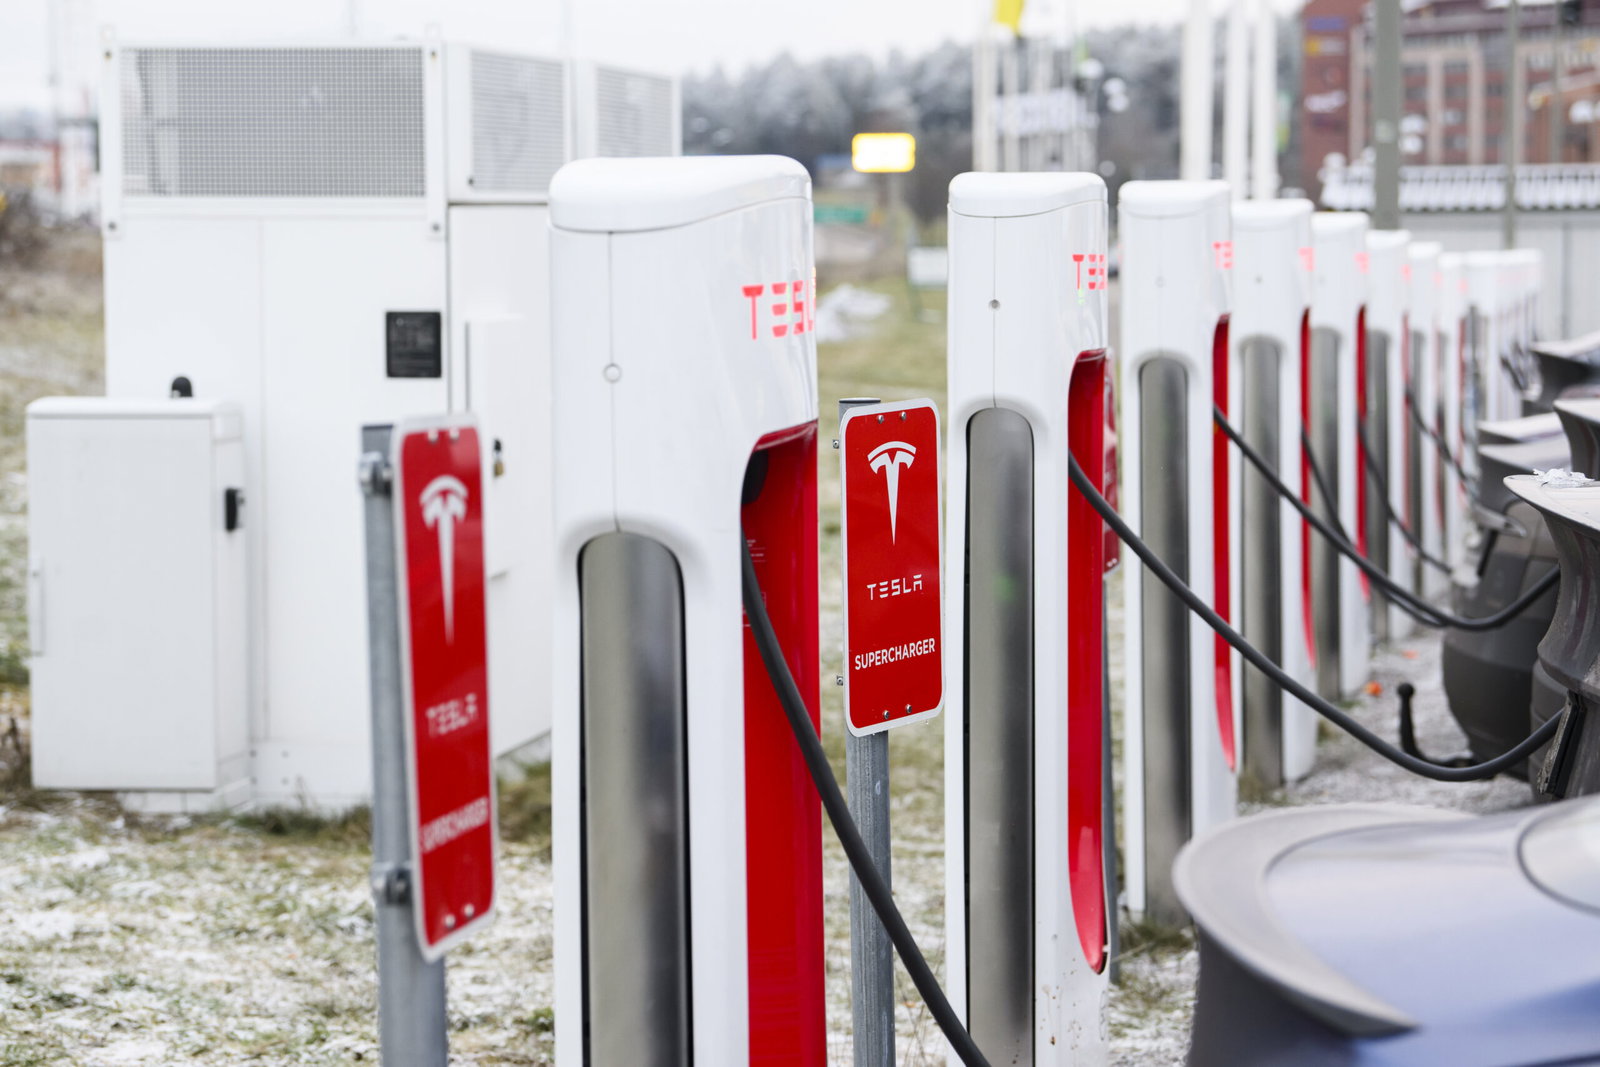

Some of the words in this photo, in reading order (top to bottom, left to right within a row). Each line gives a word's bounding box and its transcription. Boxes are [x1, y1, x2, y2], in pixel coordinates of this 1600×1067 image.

[741, 280, 815, 340] TESL
[866, 574, 922, 601] TESLA
[855, 638, 936, 670] SUPERCHARGER
